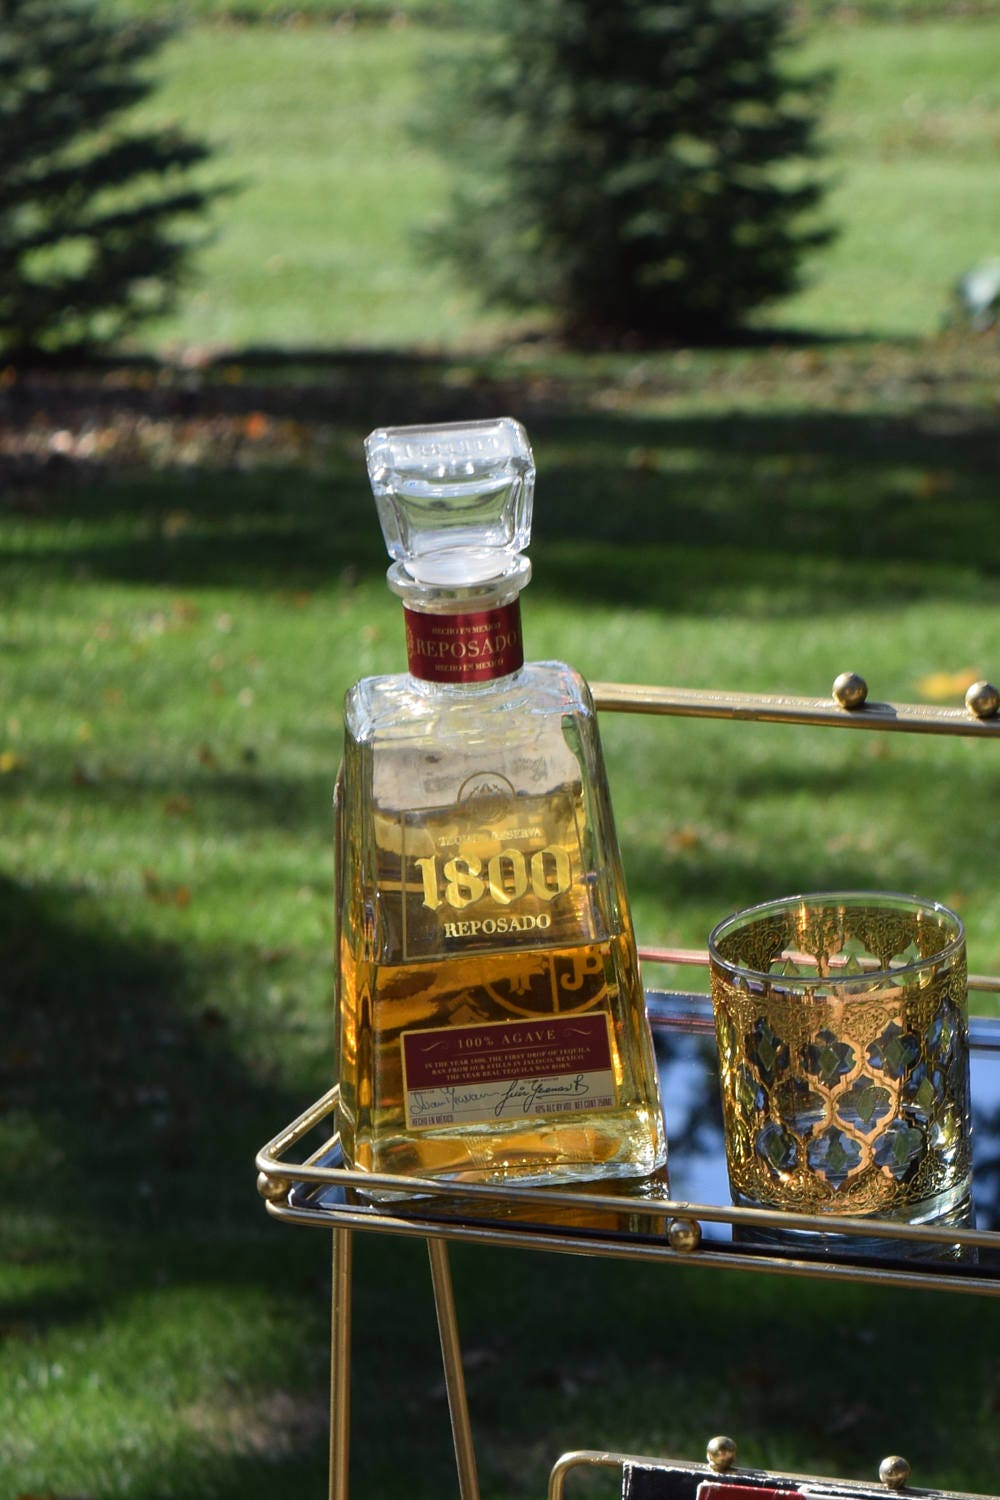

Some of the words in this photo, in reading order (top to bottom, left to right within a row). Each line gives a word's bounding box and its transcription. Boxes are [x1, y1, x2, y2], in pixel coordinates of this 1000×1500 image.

[416, 632, 517, 658] REPOSADO
[414, 845, 572, 911] 1800
[444, 914, 551, 938] REPOSADO
[458, 1036, 494, 1048] 100%
[502, 1030, 556, 1044] AGAVE
